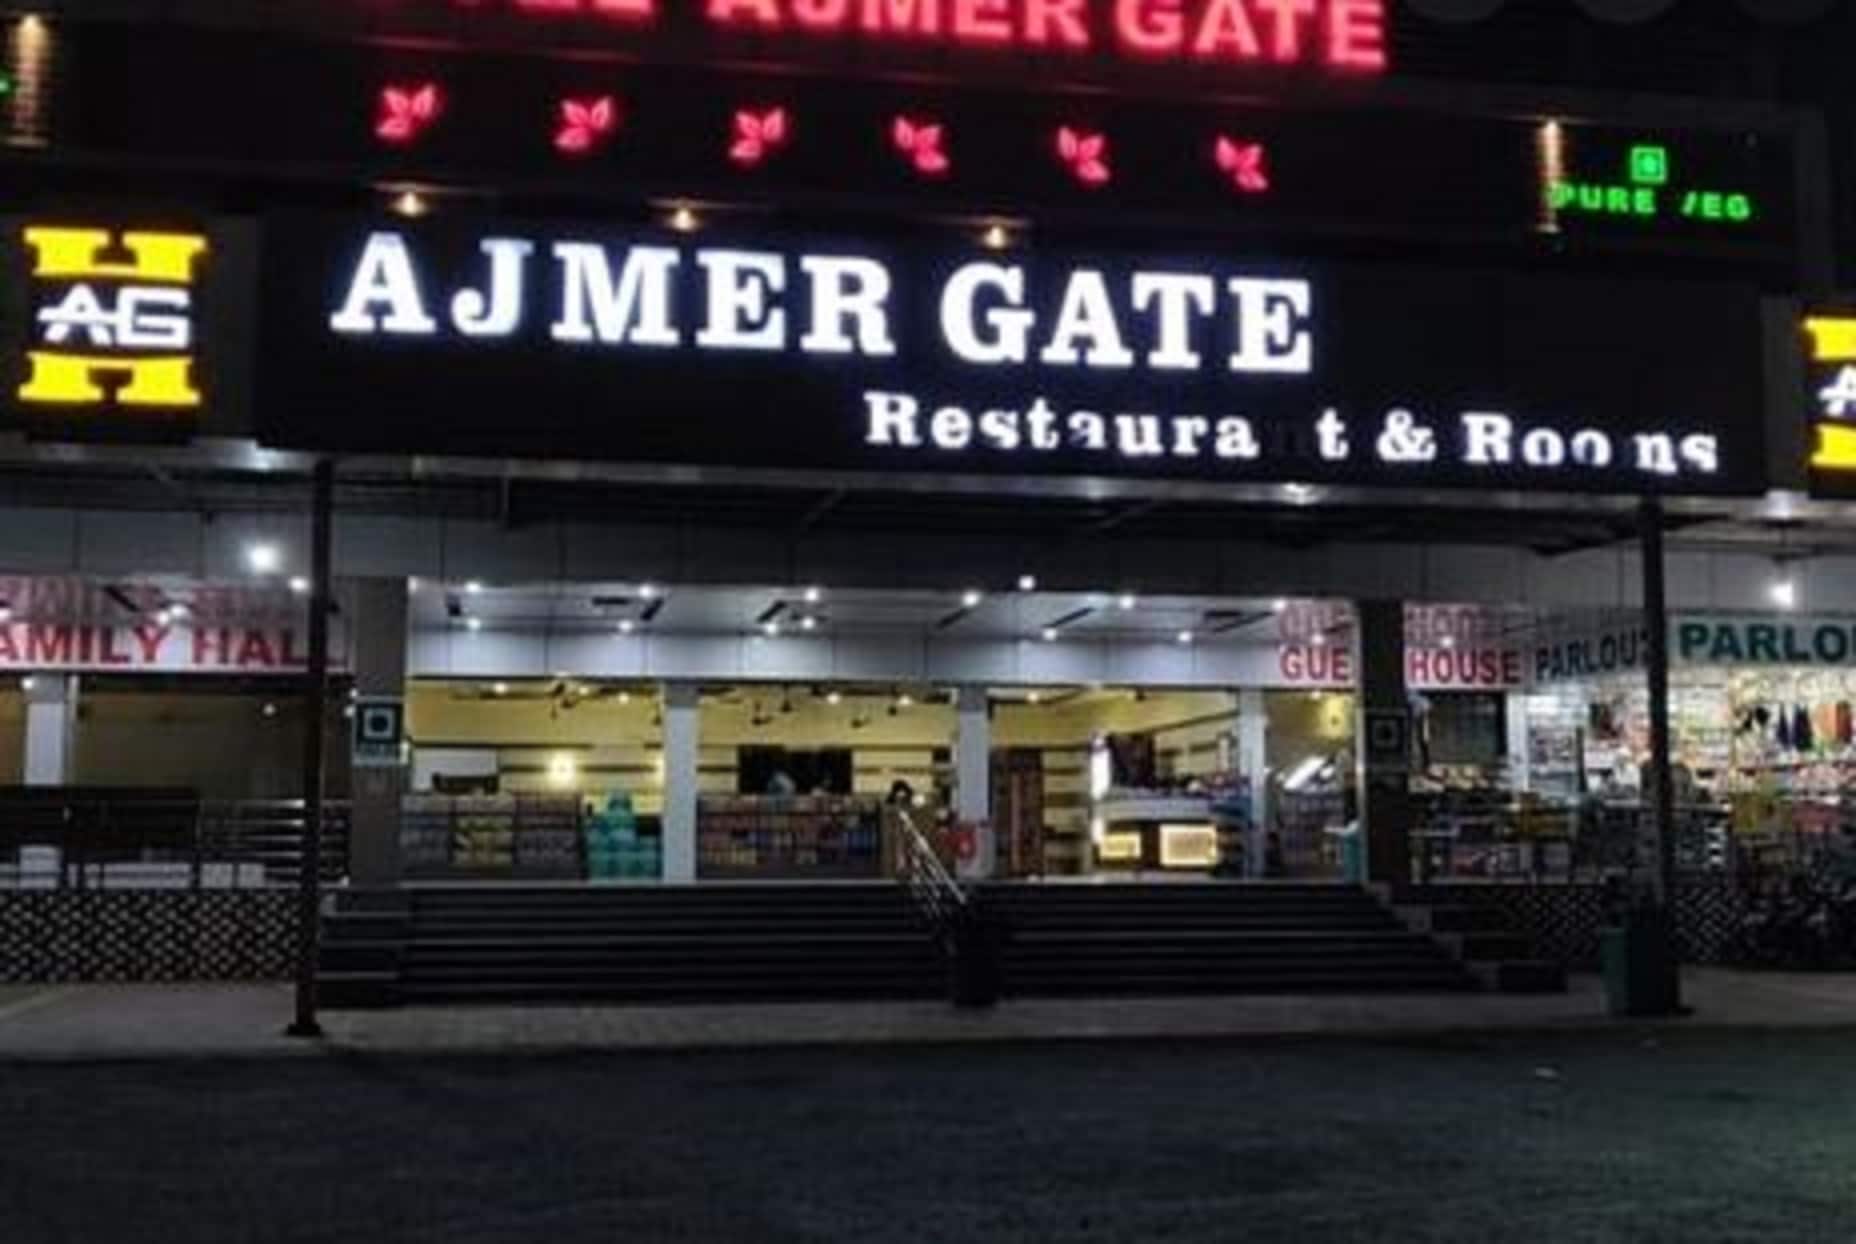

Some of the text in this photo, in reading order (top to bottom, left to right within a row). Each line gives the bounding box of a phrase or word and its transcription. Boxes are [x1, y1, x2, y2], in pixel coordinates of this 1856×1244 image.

[1114, 0, 1386, 66] GATE
[1549, 181, 1656, 214] PURE
[330, 229, 1313, 374] AJMER GATE
[863, 391, 1349, 459] Restaurat
[1376, 409, 1437, 462] &
[1406, 648, 1521, 684] HOUSE
[1535, 626, 1651, 682] PARLOU
[1679, 622, 1856, 664] PARLO
